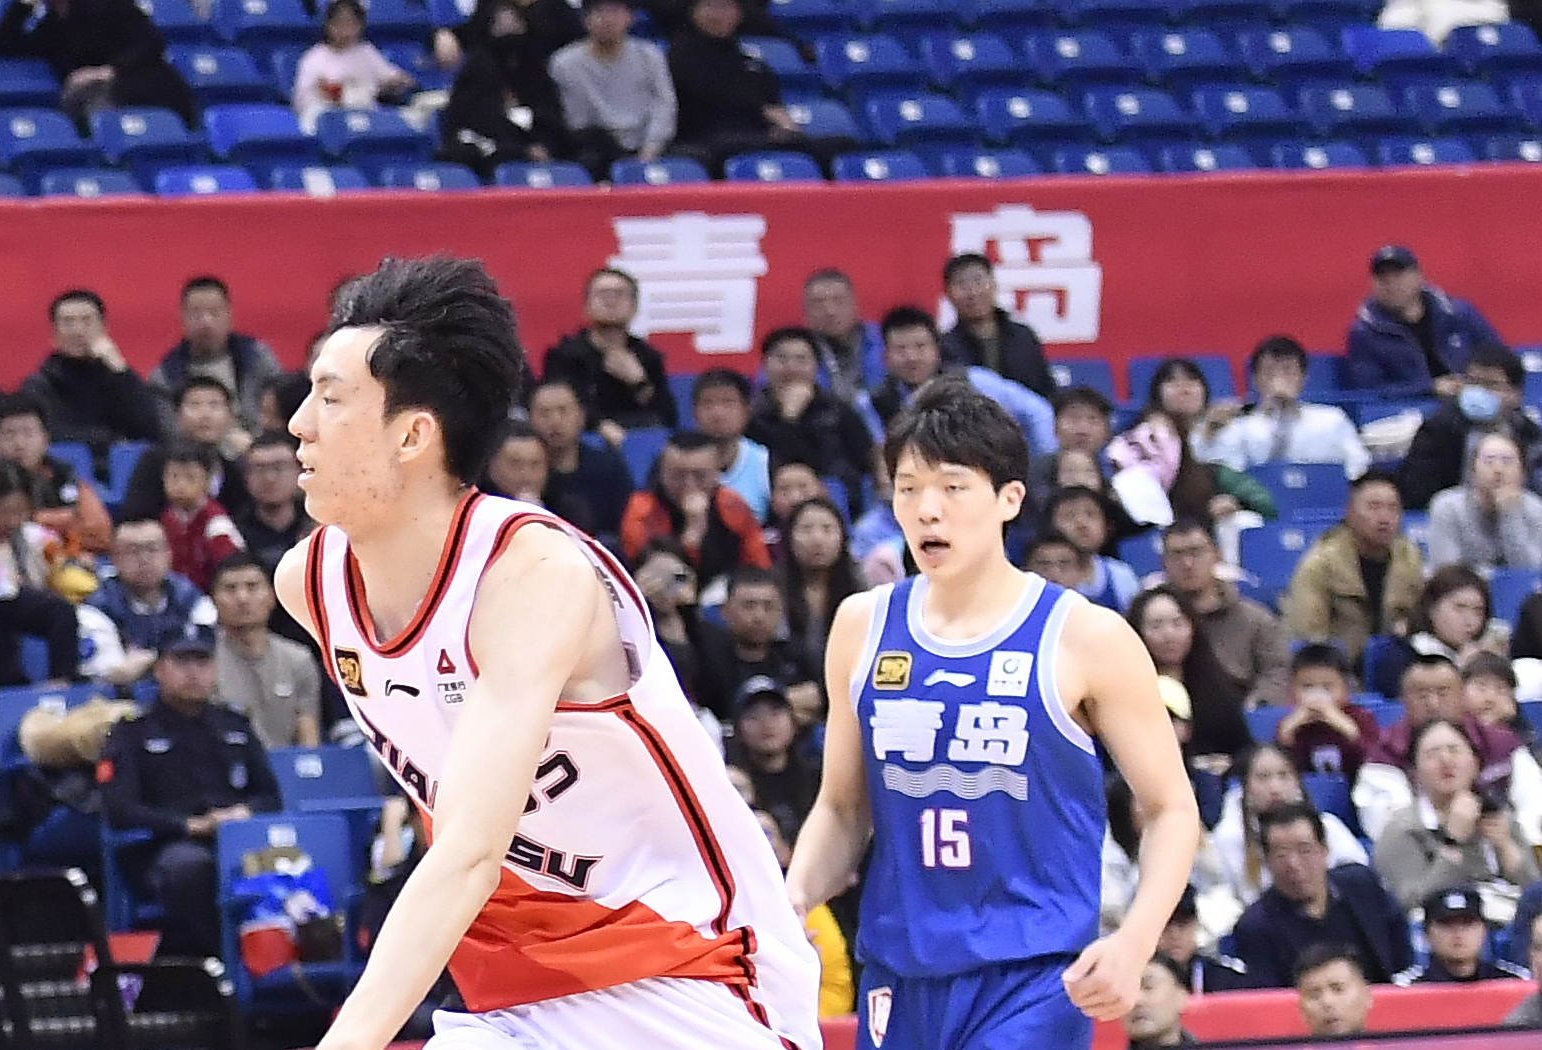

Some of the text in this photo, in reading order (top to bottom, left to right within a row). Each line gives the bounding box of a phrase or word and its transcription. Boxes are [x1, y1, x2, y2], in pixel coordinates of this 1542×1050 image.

[608, 205, 1102, 354] 青岛
[870, 697, 1029, 766] 青岛
[351, 700, 605, 893] JIASU
[919, 806, 972, 869] 15
